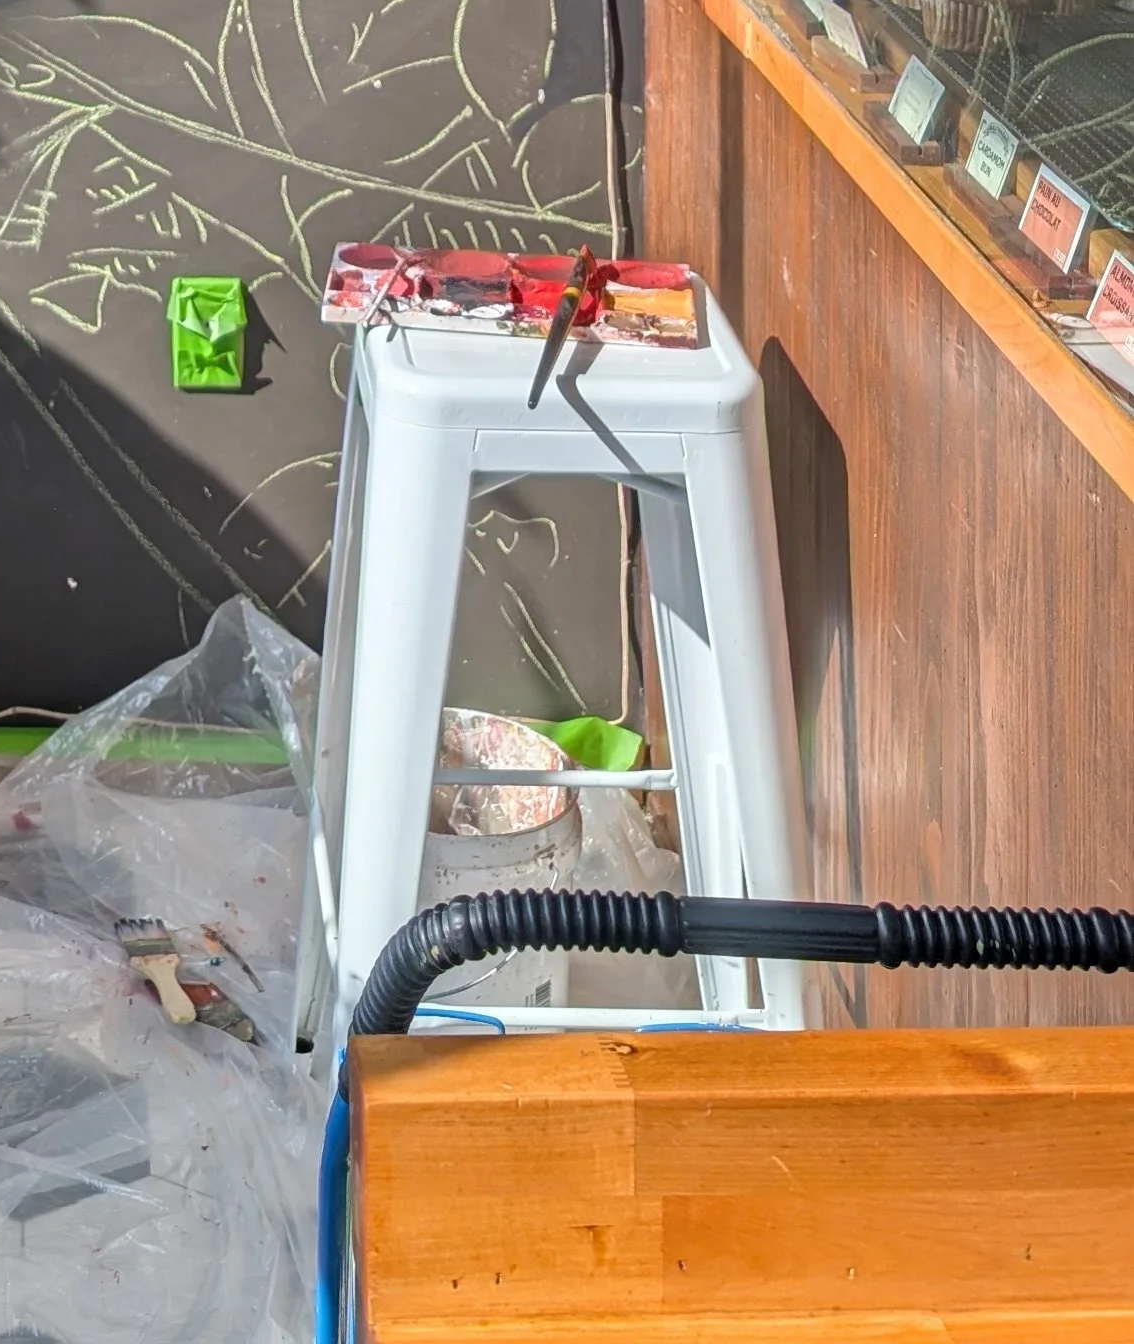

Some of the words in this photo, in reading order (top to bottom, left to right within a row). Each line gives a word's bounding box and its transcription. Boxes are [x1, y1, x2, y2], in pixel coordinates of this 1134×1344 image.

[978, 140, 1005, 169] CARDAMOM
[980, 160, 992, 178] BUN
[1037, 180, 1053, 202] PAIN
[1050, 192, 1062, 209] AU
[1031, 198, 1062, 230] CHOCOLAT
[1110, 265, 1134, 298] ALMON
[1103, 283, 1134, 326] CROISSAN
